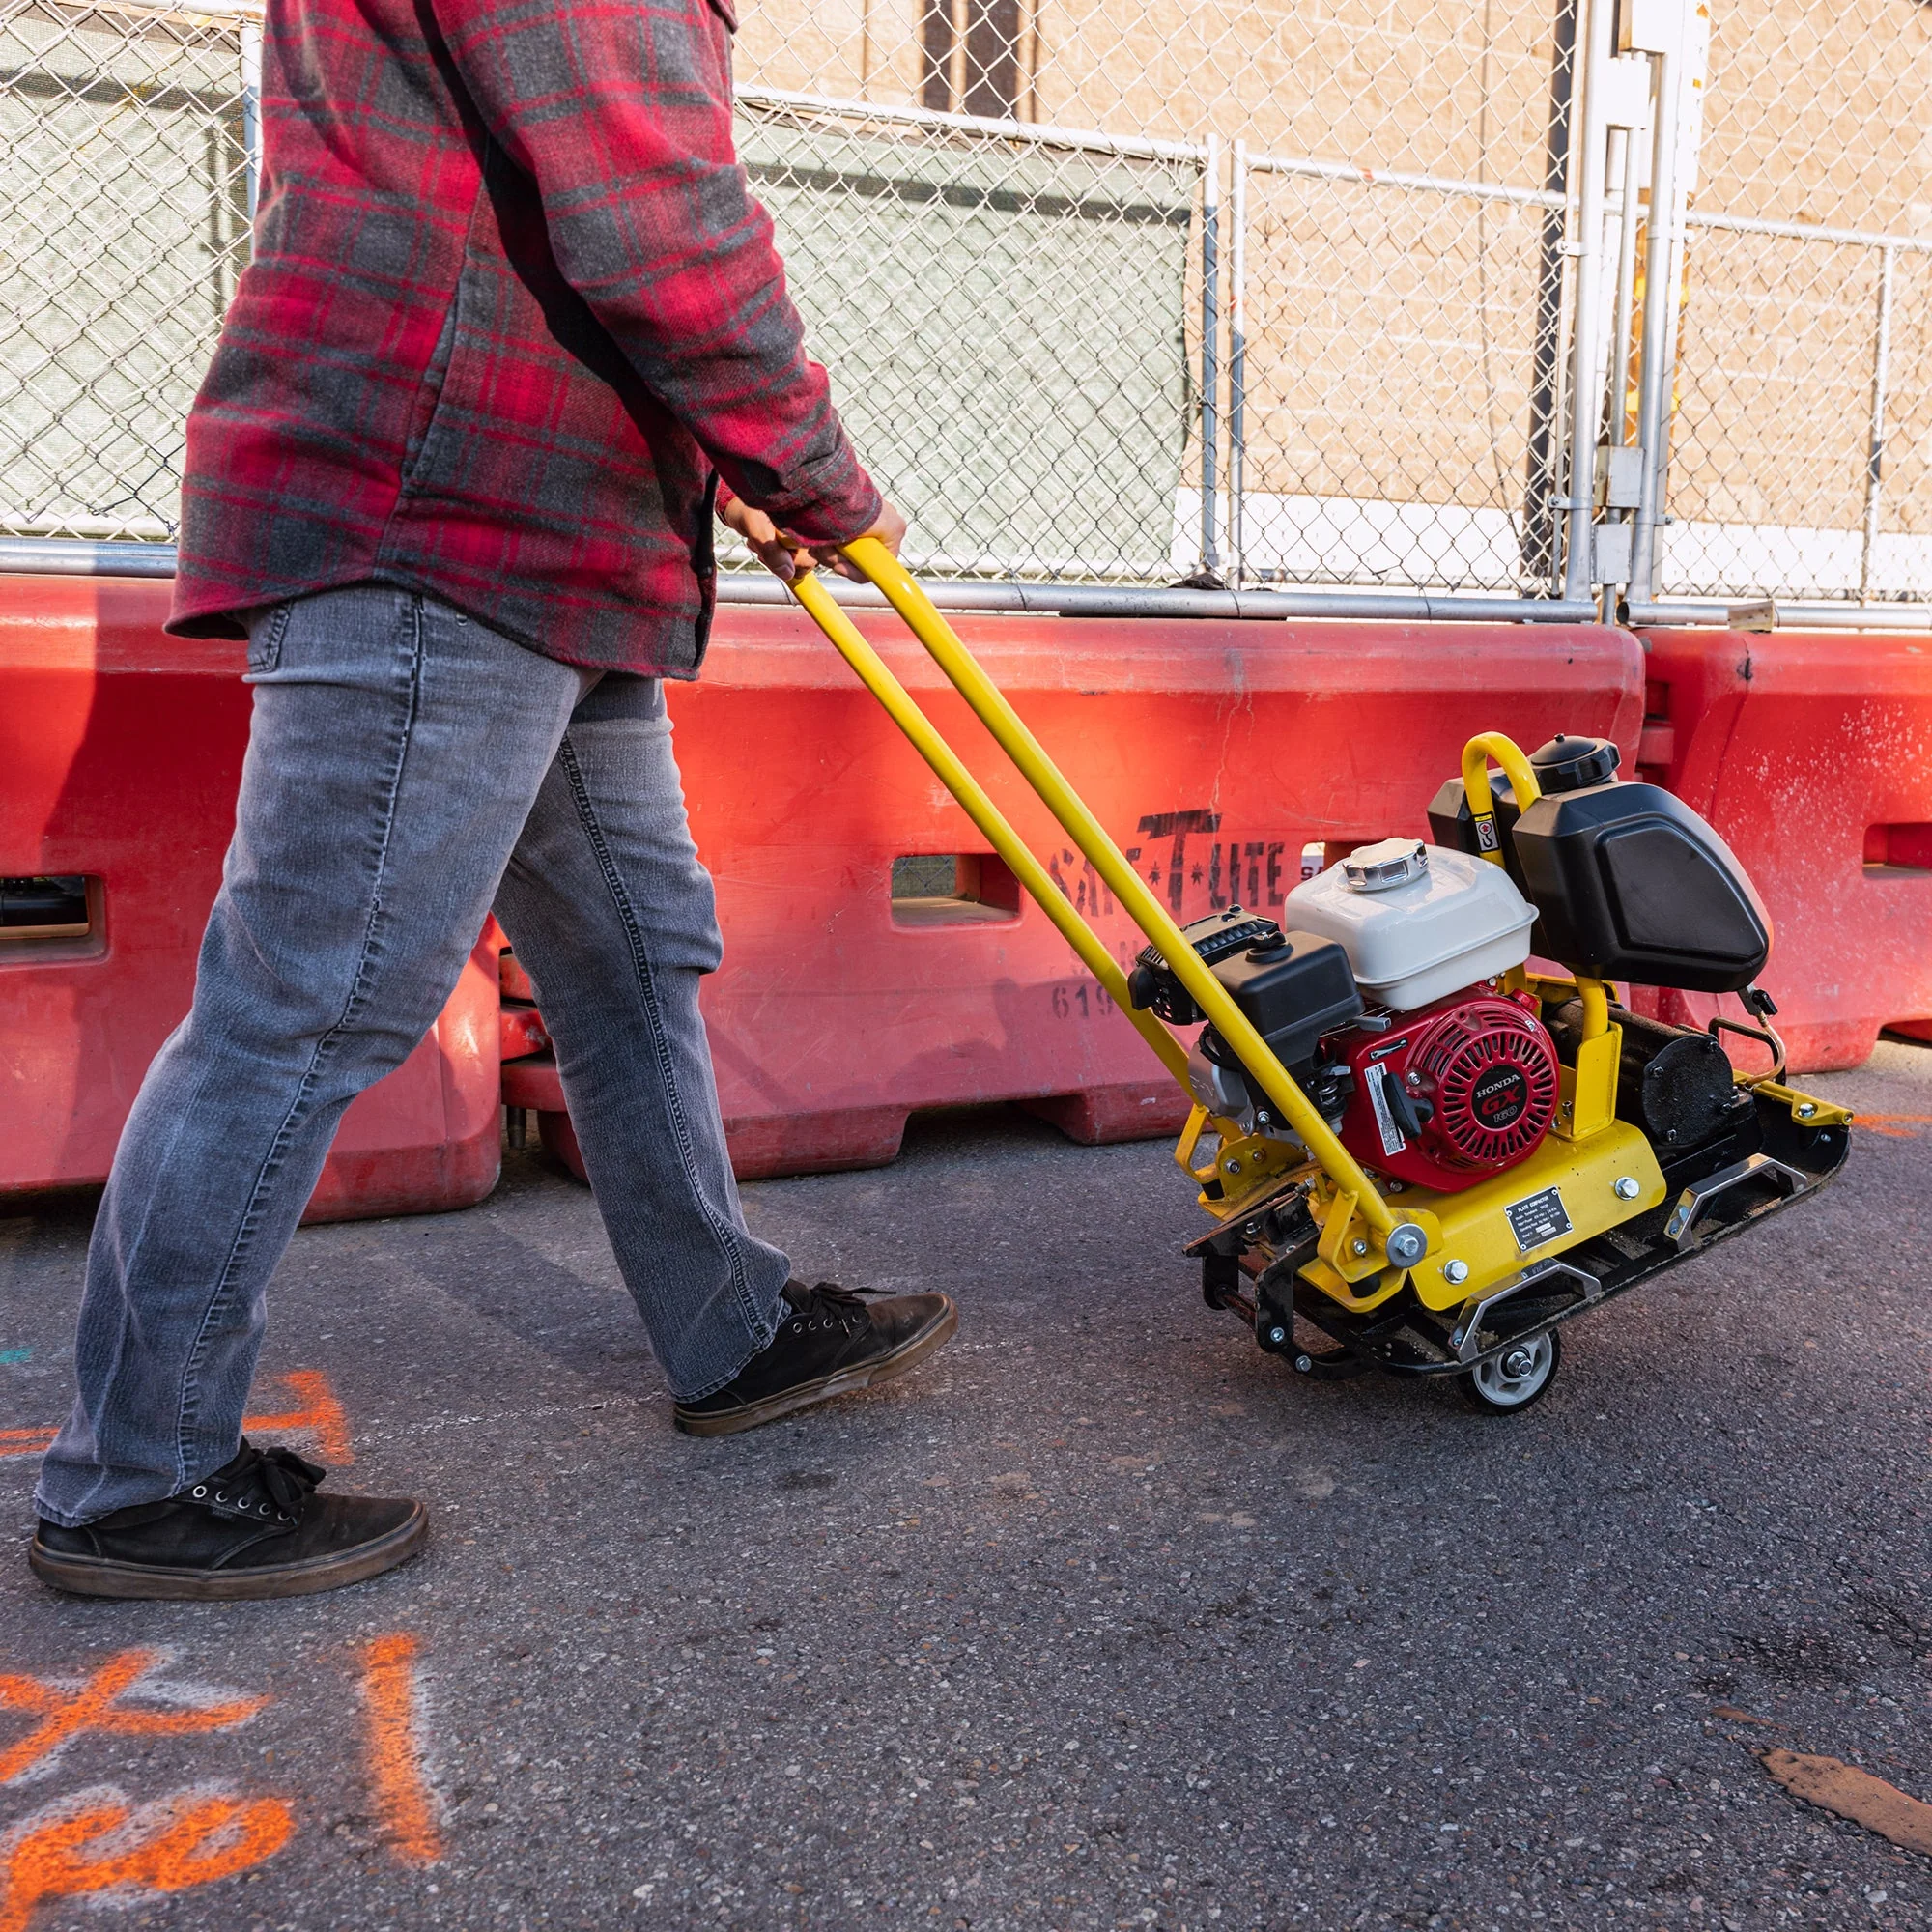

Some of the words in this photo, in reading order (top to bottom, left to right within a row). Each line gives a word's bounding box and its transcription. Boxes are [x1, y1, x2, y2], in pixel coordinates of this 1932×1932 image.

[1476, 1074, 1520, 1098] HONDA
[1482, 1085, 1520, 1116] GX
[1518, 1204, 1530, 1212] PLATE
